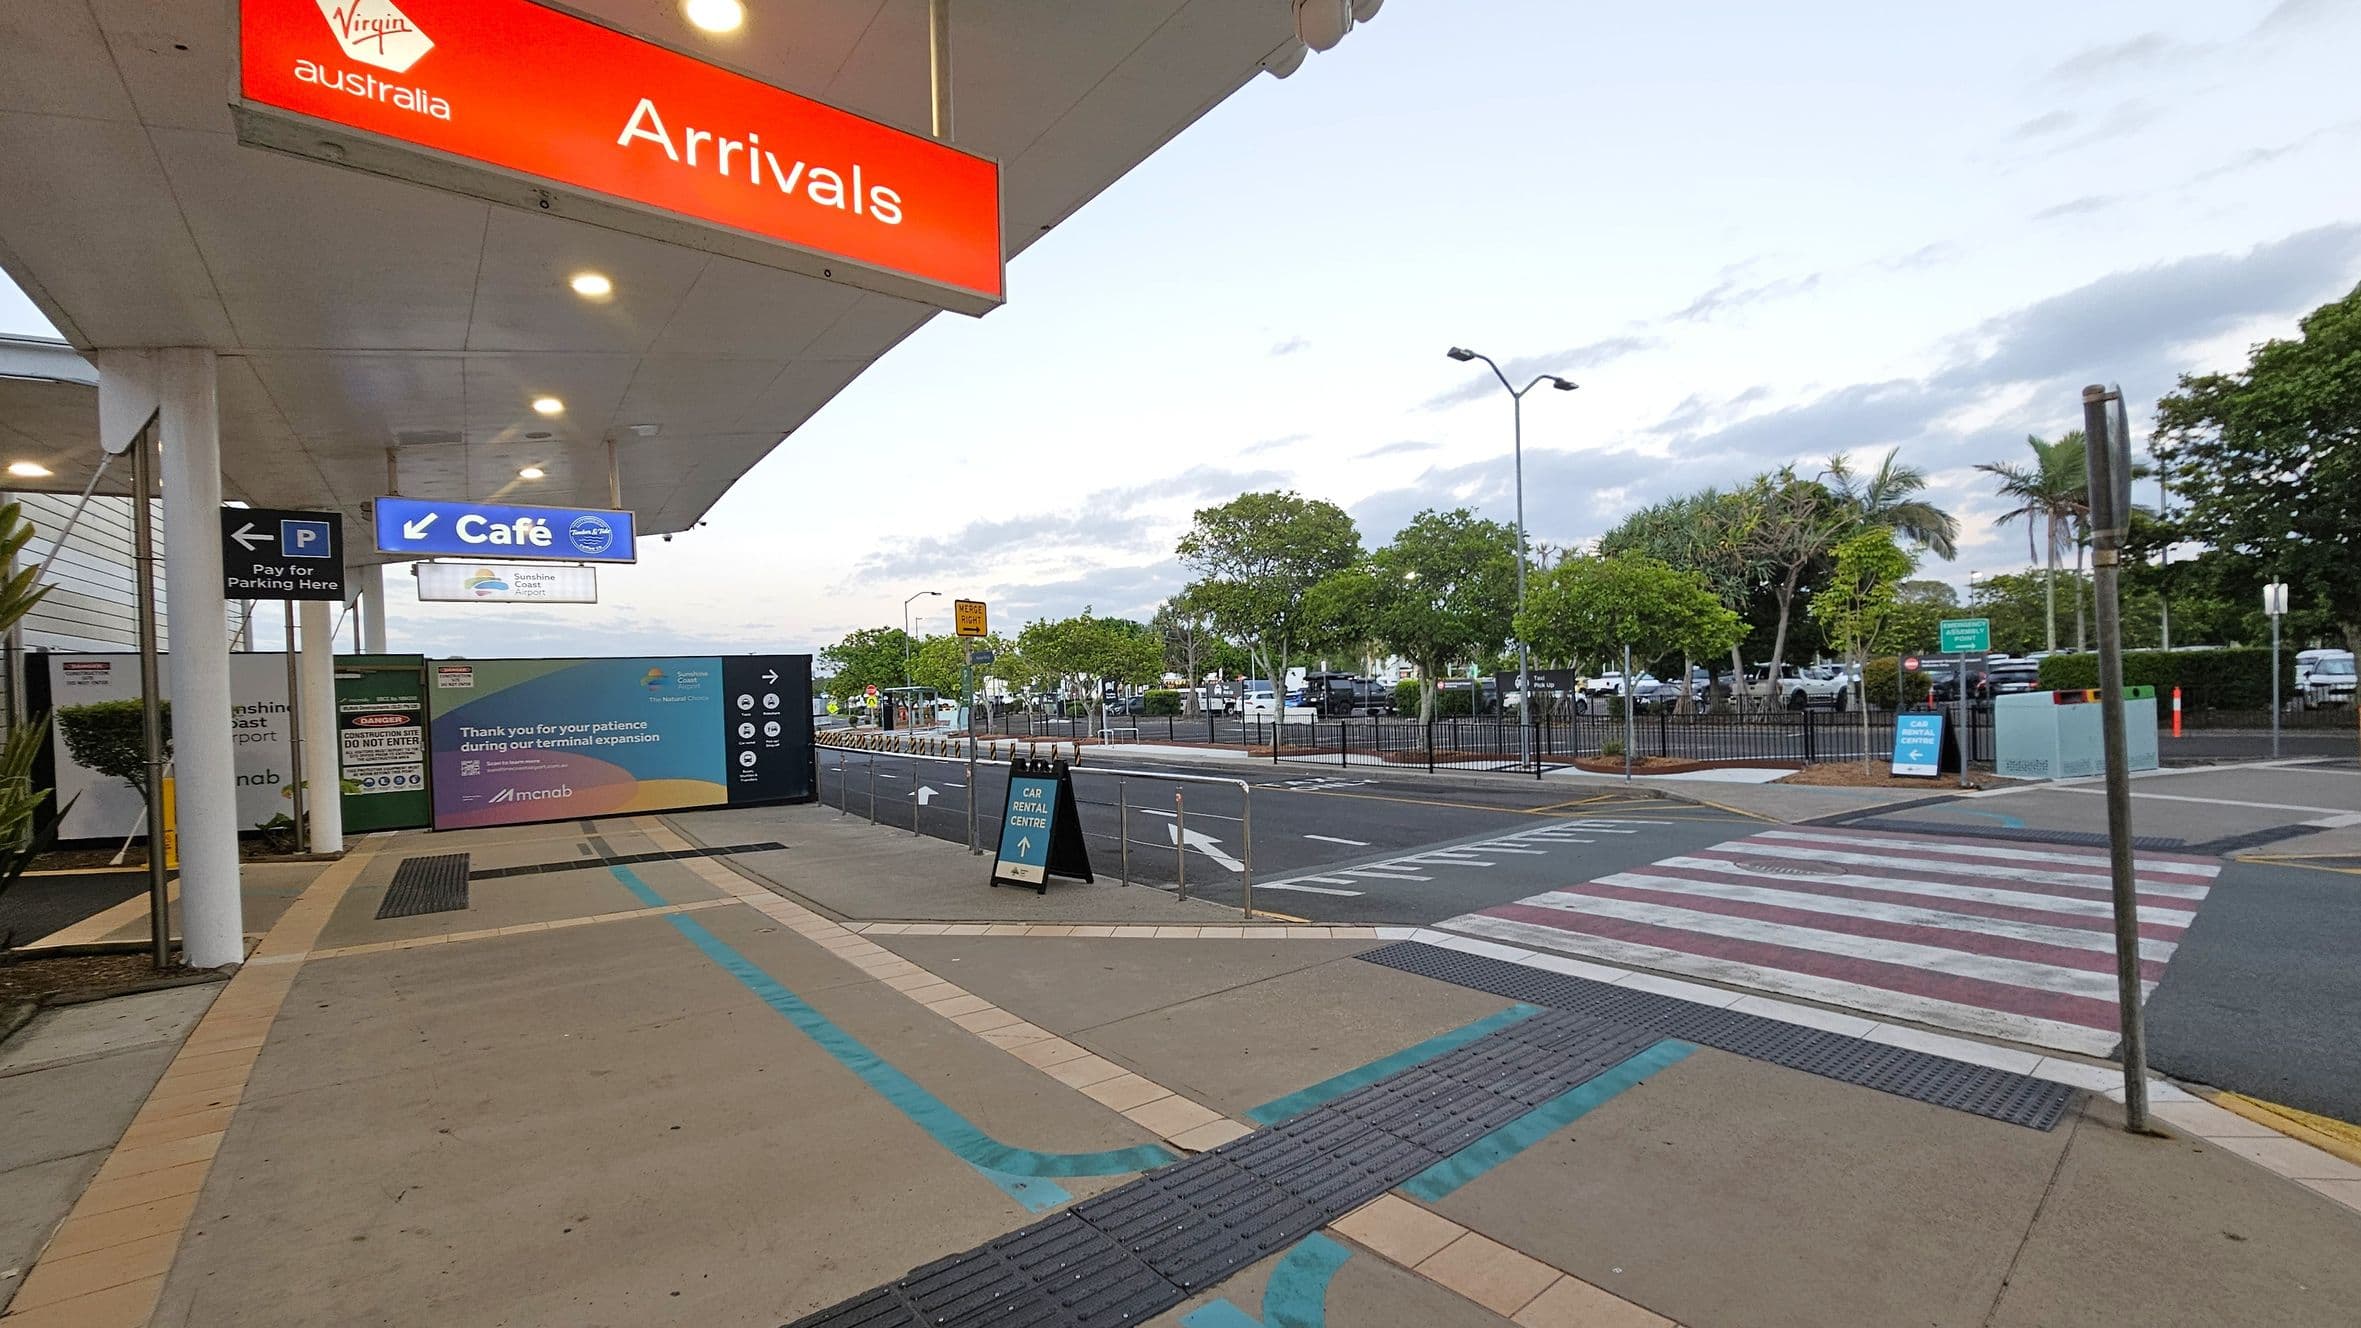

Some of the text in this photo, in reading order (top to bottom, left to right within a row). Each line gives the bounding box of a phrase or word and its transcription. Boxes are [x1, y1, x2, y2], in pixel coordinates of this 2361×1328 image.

[333, 0, 413, 55] Virgin
[294, 59, 451, 120] australia
[616, 97, 903, 225] Arrivals
[456, 514, 553, 547] Café
[253, 564, 314, 577] Pay for
[514, 573, 556, 581] Sunshine
[228, 577, 339, 591] Parking Here
[514, 580, 541, 589] Coast
[514, 589, 546, 597] Airport
[960, 605, 982, 614] MERGE
[962, 615, 981, 625] RIGHT
[236, 702, 291, 714] nshin
[232, 718, 268, 729] oast
[361, 717, 403, 725] DANGER
[345, 731, 402, 740] CONSTRUCTION
[460, 721, 648, 738] Thank you for your patience
[233, 732, 278, 746] rport
[345, 737, 420, 748] DO NOT ENTER
[460, 733, 660, 753] during our terminal expansion
[1901, 737, 1935, 745] CENTRE
[237, 769, 280, 787] nab
[517, 784, 573, 801] mcnab
[1023, 788, 1042, 798] CAR
[1013, 801, 1048, 814] RENTAL
[1011, 816, 1047, 829] CENTRE
